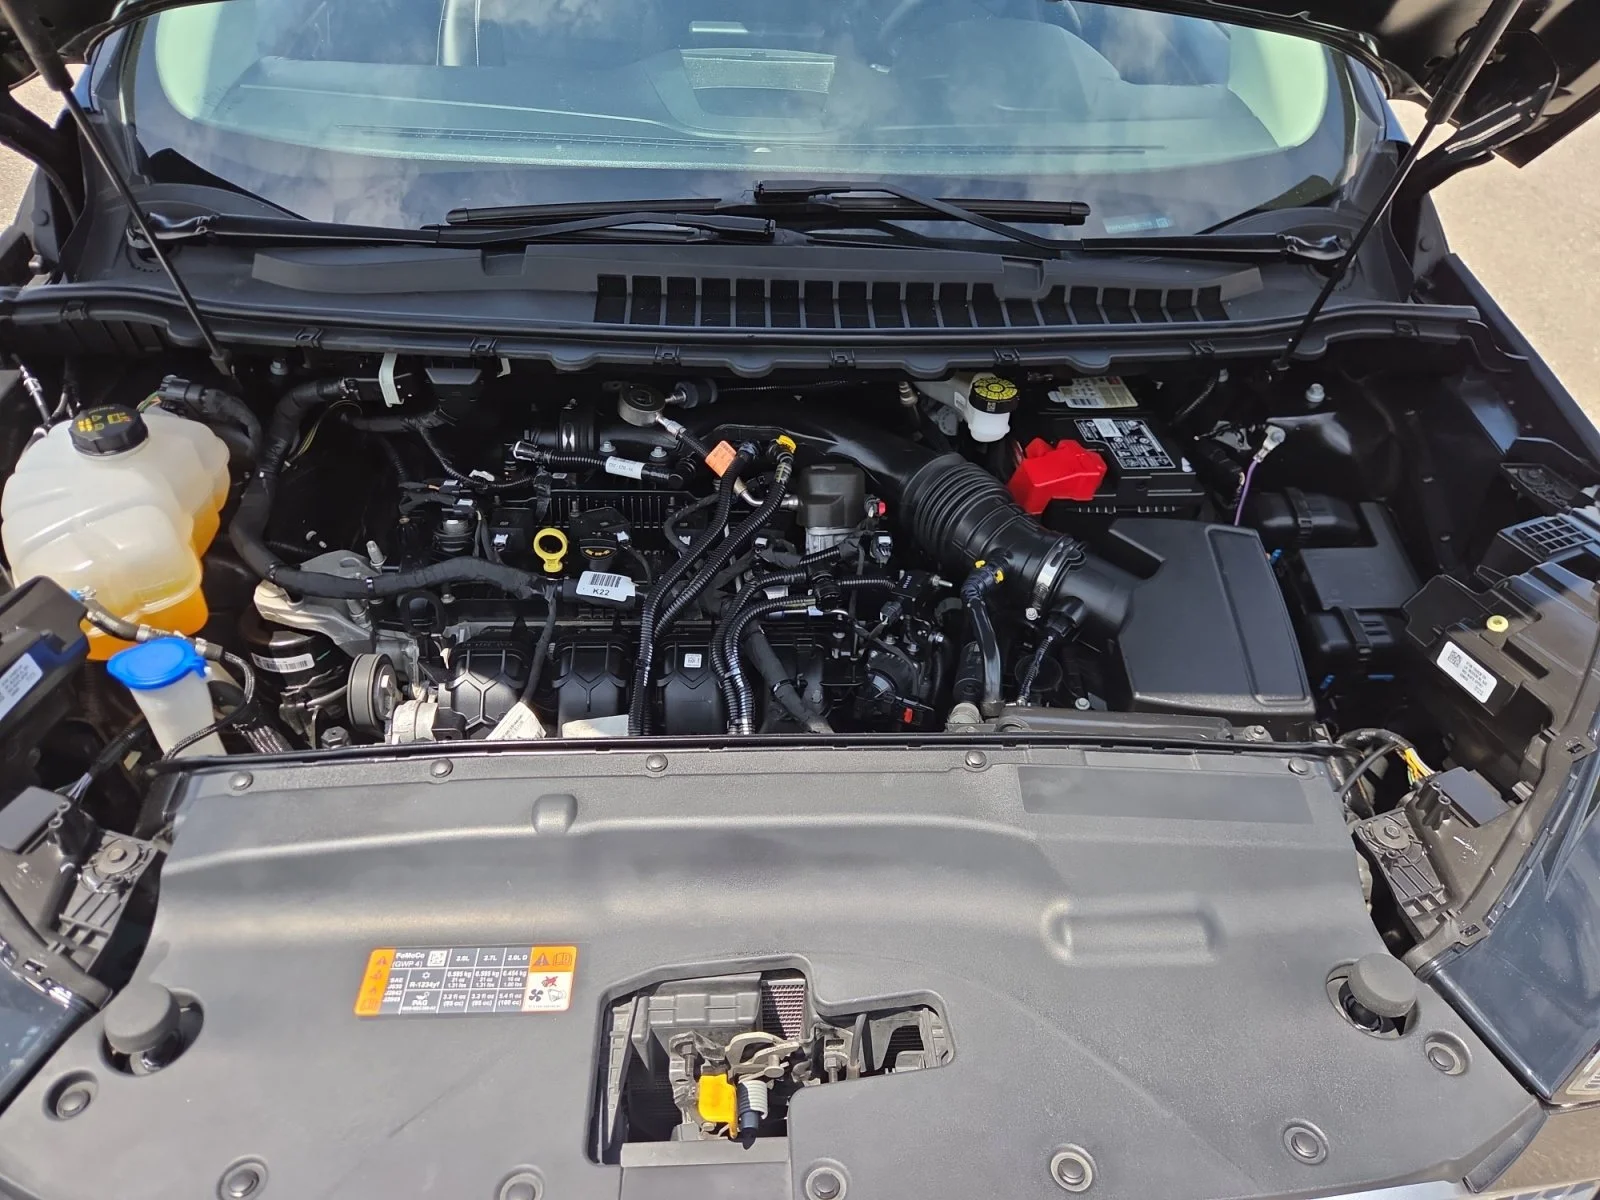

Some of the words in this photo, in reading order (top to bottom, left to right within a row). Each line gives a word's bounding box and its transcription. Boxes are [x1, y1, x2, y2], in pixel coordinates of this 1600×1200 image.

[593, 588, 610, 596] K22
[396, 952, 425, 960] FoMoCo
[392, 960, 414, 968] (GWP
[415, 960, 423, 968] 4)
[409, 981, 440, 989] R-1234yf
